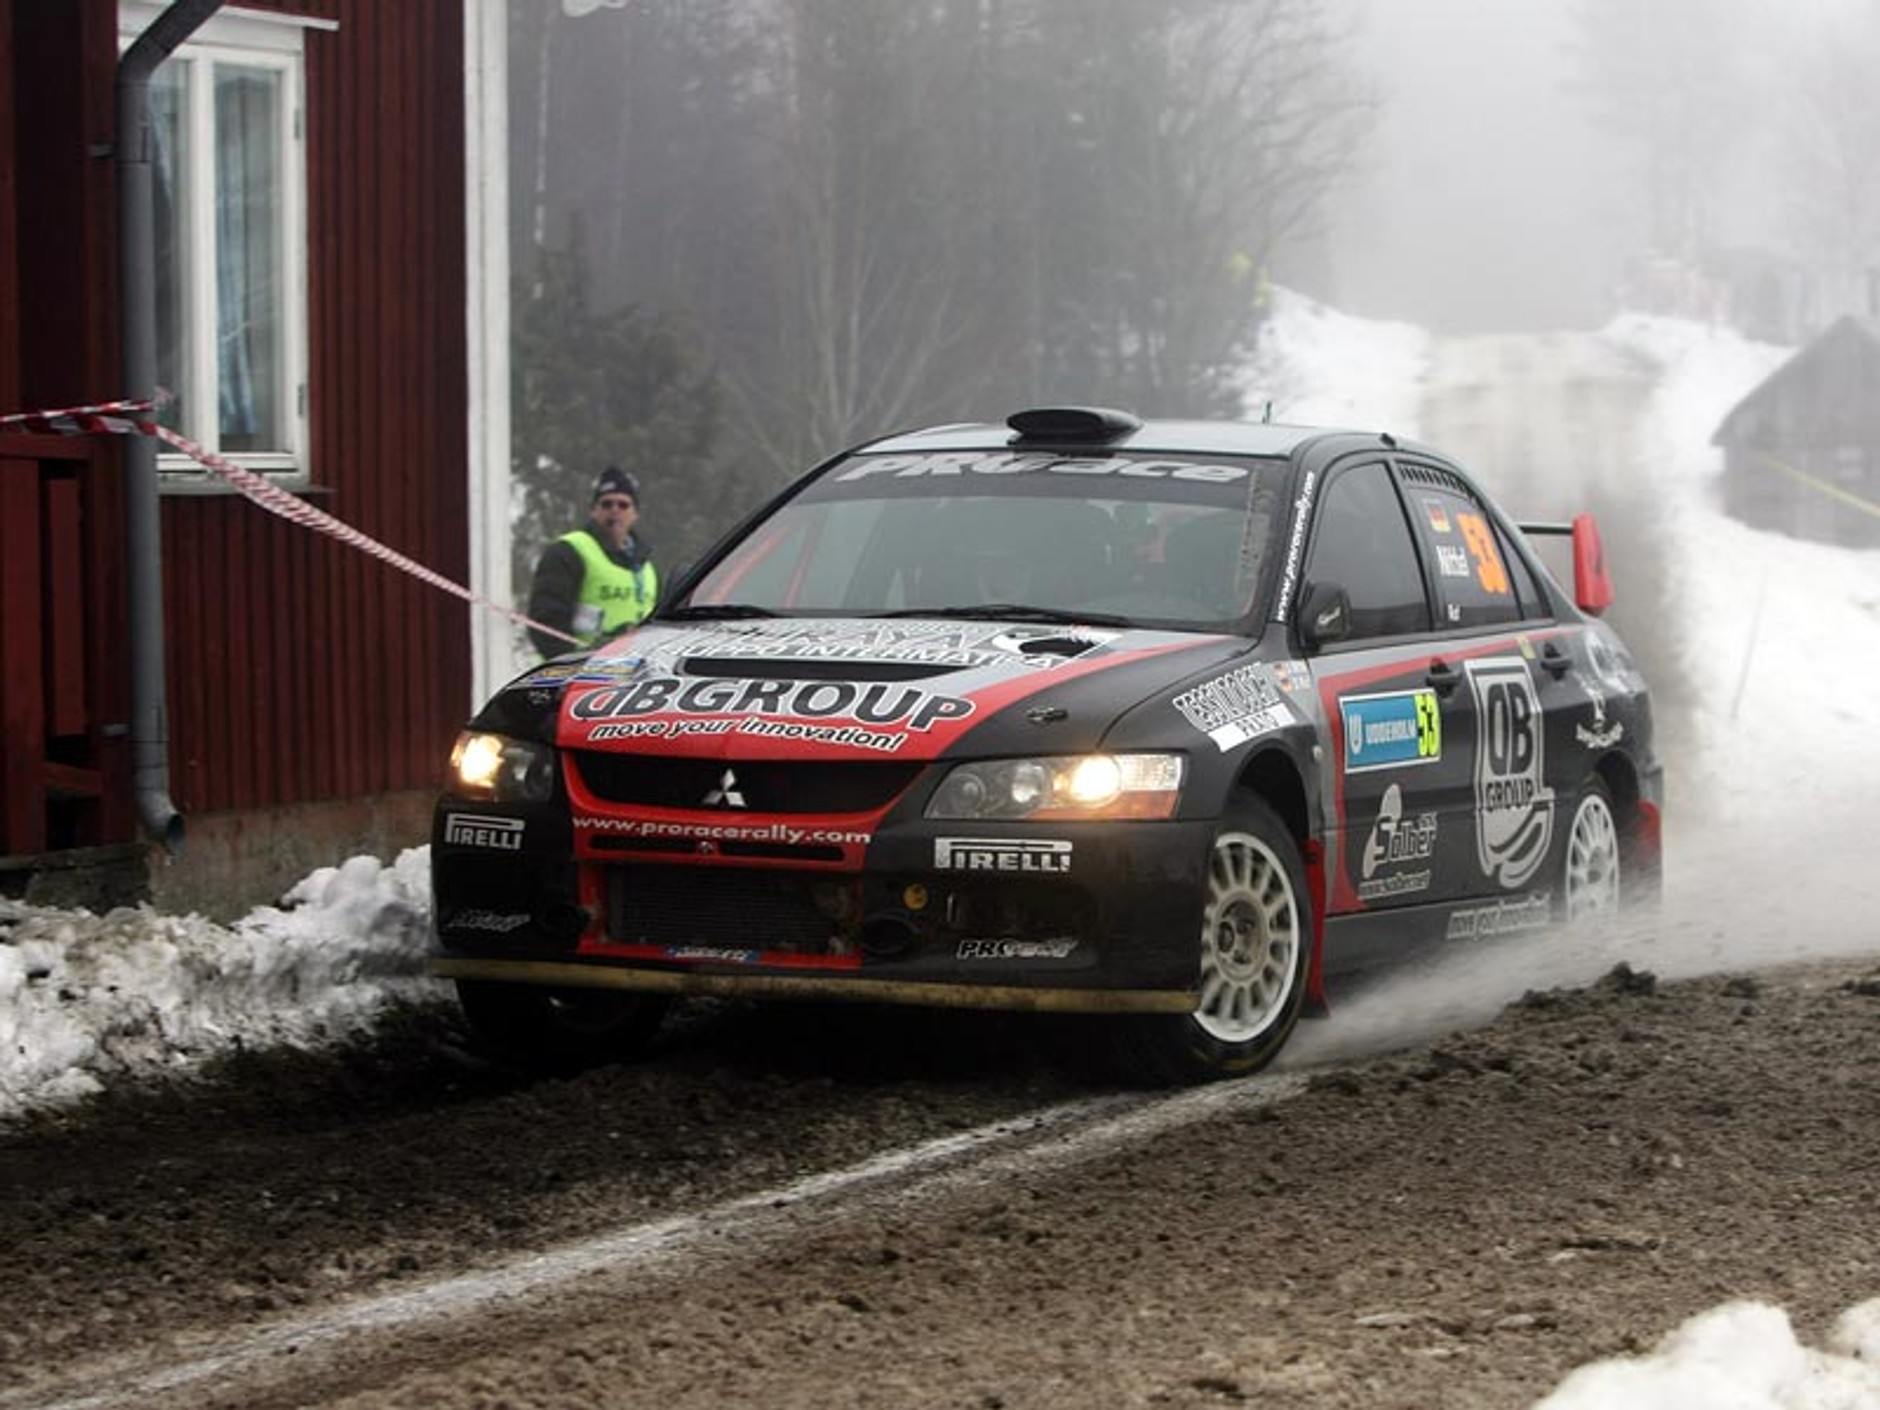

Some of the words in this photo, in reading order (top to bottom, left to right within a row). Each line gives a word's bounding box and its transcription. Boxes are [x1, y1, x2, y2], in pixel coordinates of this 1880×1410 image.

[588, 719, 668, 742] move
[667, 716, 739, 739] your
[739, 717, 909, 753] innovation!
[1414, 692, 1440, 757] 53
[1484, 777, 1535, 813] GROUP
[444, 813, 526, 851] PIRELLI
[571, 816, 872, 846] www.proracerally.com
[934, 837, 1074, 873] PIRELLI
